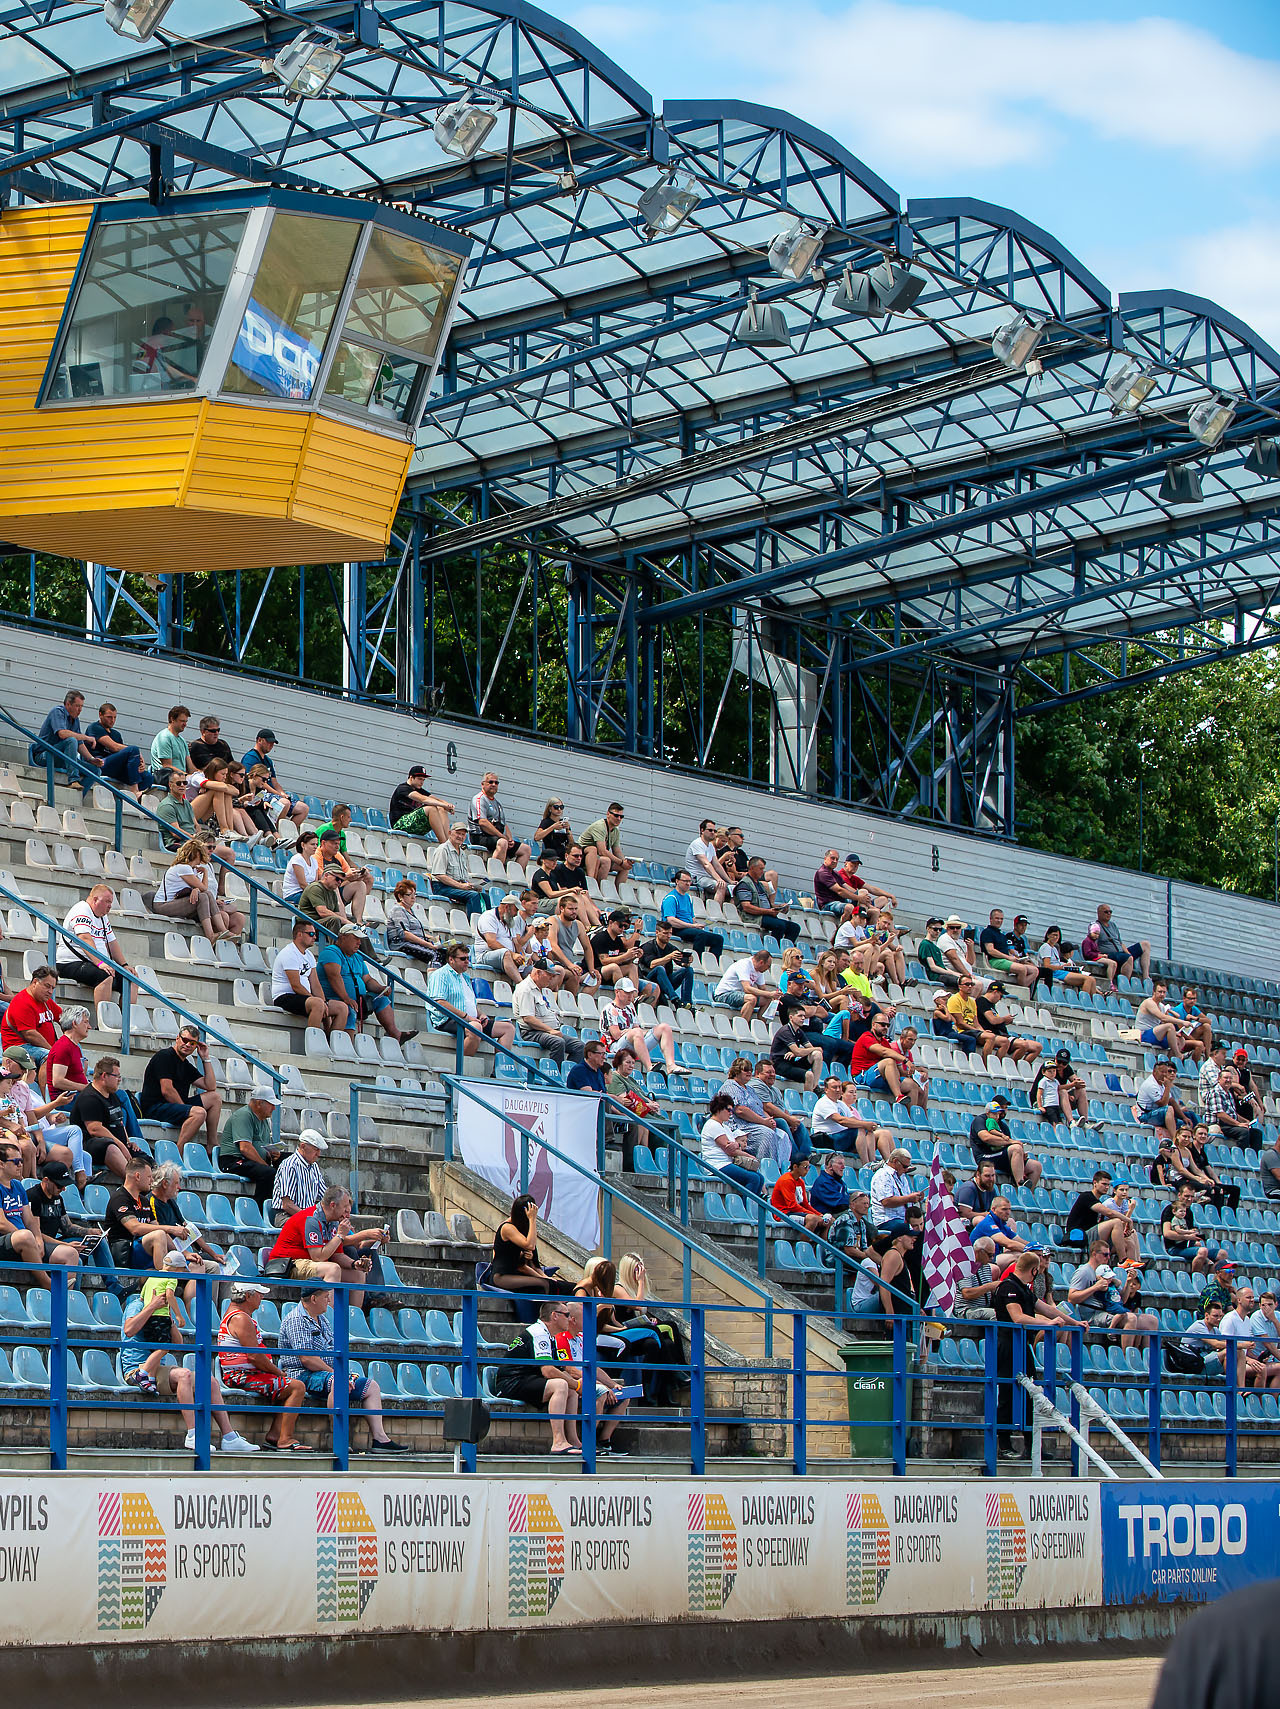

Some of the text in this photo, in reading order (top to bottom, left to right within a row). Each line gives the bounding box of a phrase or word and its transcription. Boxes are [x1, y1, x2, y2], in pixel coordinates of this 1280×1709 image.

[446, 741, 458, 774] C
[504, 1098, 549, 1115] DAUGAVPILS
[853, 1381, 885, 1390] Clean R
[175, 1494, 272, 1530] DAUGAVPILS
[384, 1494, 471, 1528] DAUGAVPILS
[570, 1495, 652, 1527] DAUGAVPILS
[742, 1495, 815, 1526] DAUGAVPILS
[894, 1495, 958, 1524] DAUGAVPILS
[1029, 1494, 1089, 1522] DAUGAVPILS
[1030, 1532, 1086, 1560] IS SPEEDWAY
[1119, 1504, 1247, 1557] TRODO
[175, 1543, 246, 1578] IR SPORTS
[384, 1540, 465, 1574] IS SPEEDWAY
[571, 1539, 630, 1571] IR SPORTS
[743, 1537, 810, 1568] IS SPEEDWAY
[895, 1535, 942, 1564] IR SPORTS
[1151, 1567, 1218, 1585] CAR PARTS ONLINE
